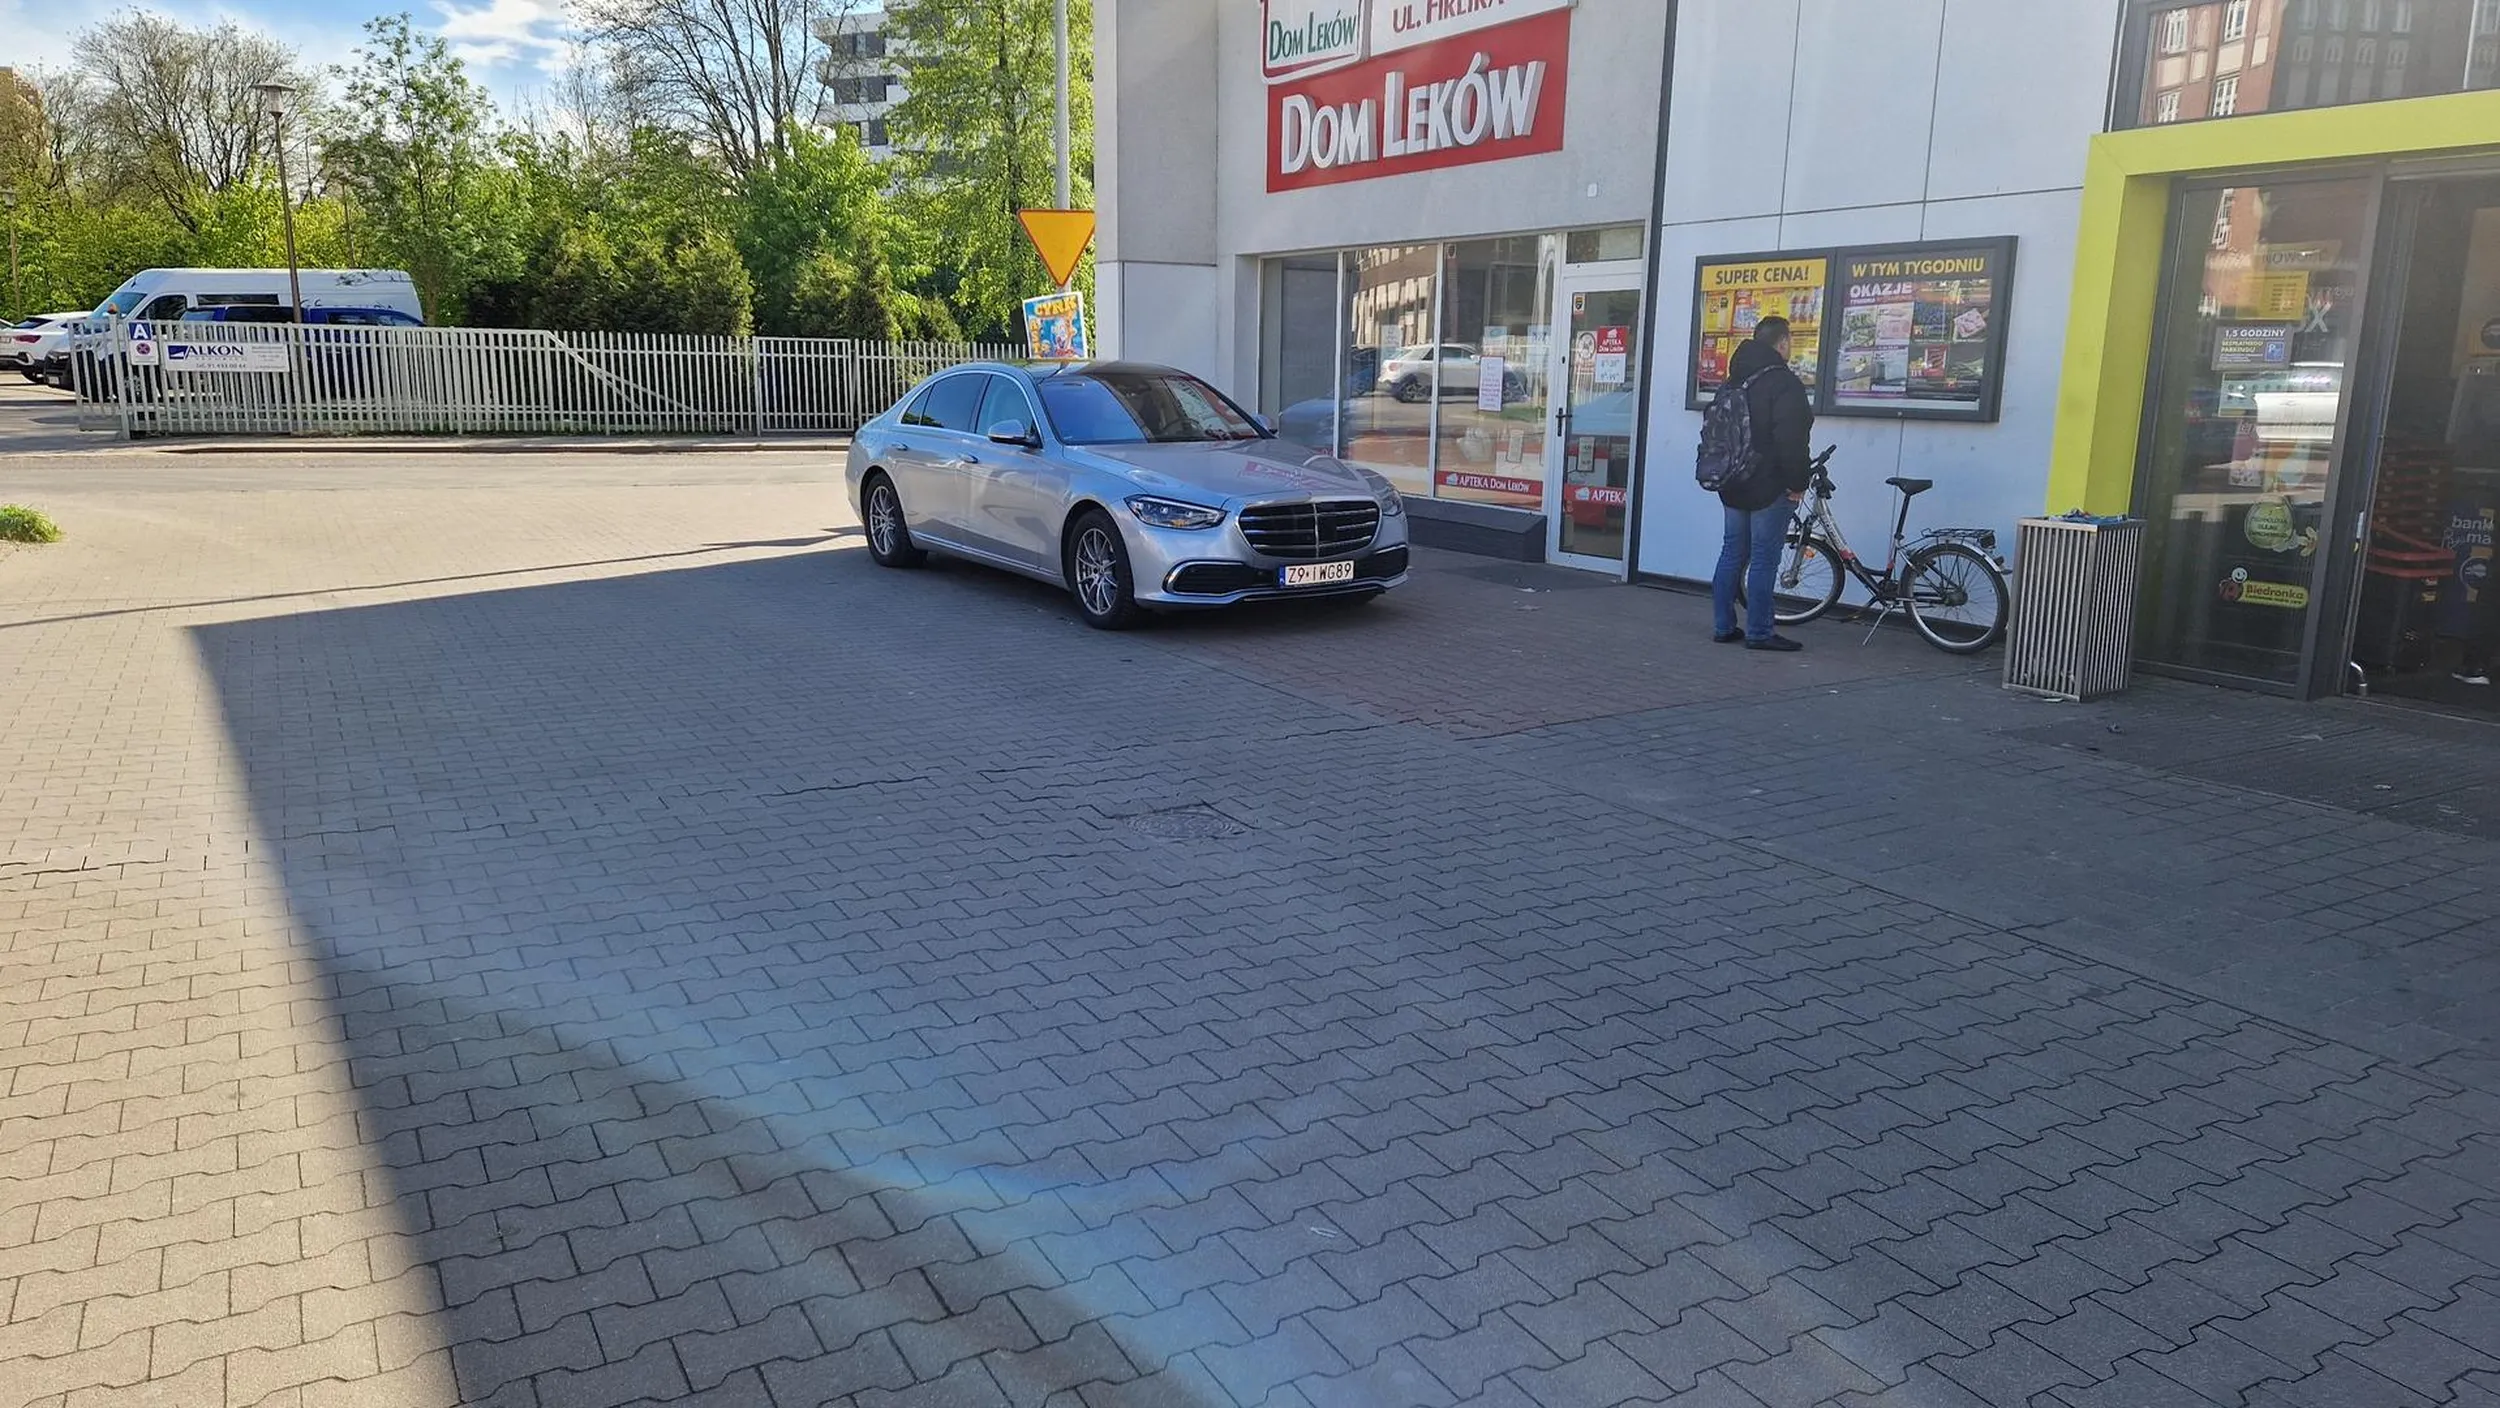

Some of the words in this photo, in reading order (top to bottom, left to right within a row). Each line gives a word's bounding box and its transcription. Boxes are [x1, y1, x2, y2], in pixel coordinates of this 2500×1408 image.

[1392, 12, 1421, 33] UL.
[1269, 19, 1303, 61] DOM
[1307, 9, 1357, 54] LEKÓW
[1281, 93, 1377, 175] DOM
[1383, 51, 1546, 158] LEKÓW
[1715, 268, 1758, 285] SUPER
[1763, 265, 1809, 282] CENA!
[1852, 264, 1867, 278] W
[1870, 262, 1899, 277] TYM
[1904, 257, 1985, 275] TYGODNIU
[1850, 281, 1913, 298] OKAZJE
[133, 324, 149, 340] A
[2225, 329, 2238, 339] 1,5
[2240, 328, 2286, 338] GODZINY
[186, 345, 243, 357] ALKON
[1459, 477, 1489, 489] APTEKA
[1288, 567, 1306, 583] Z9
[2246, 584, 2304, 599] Biedronka
